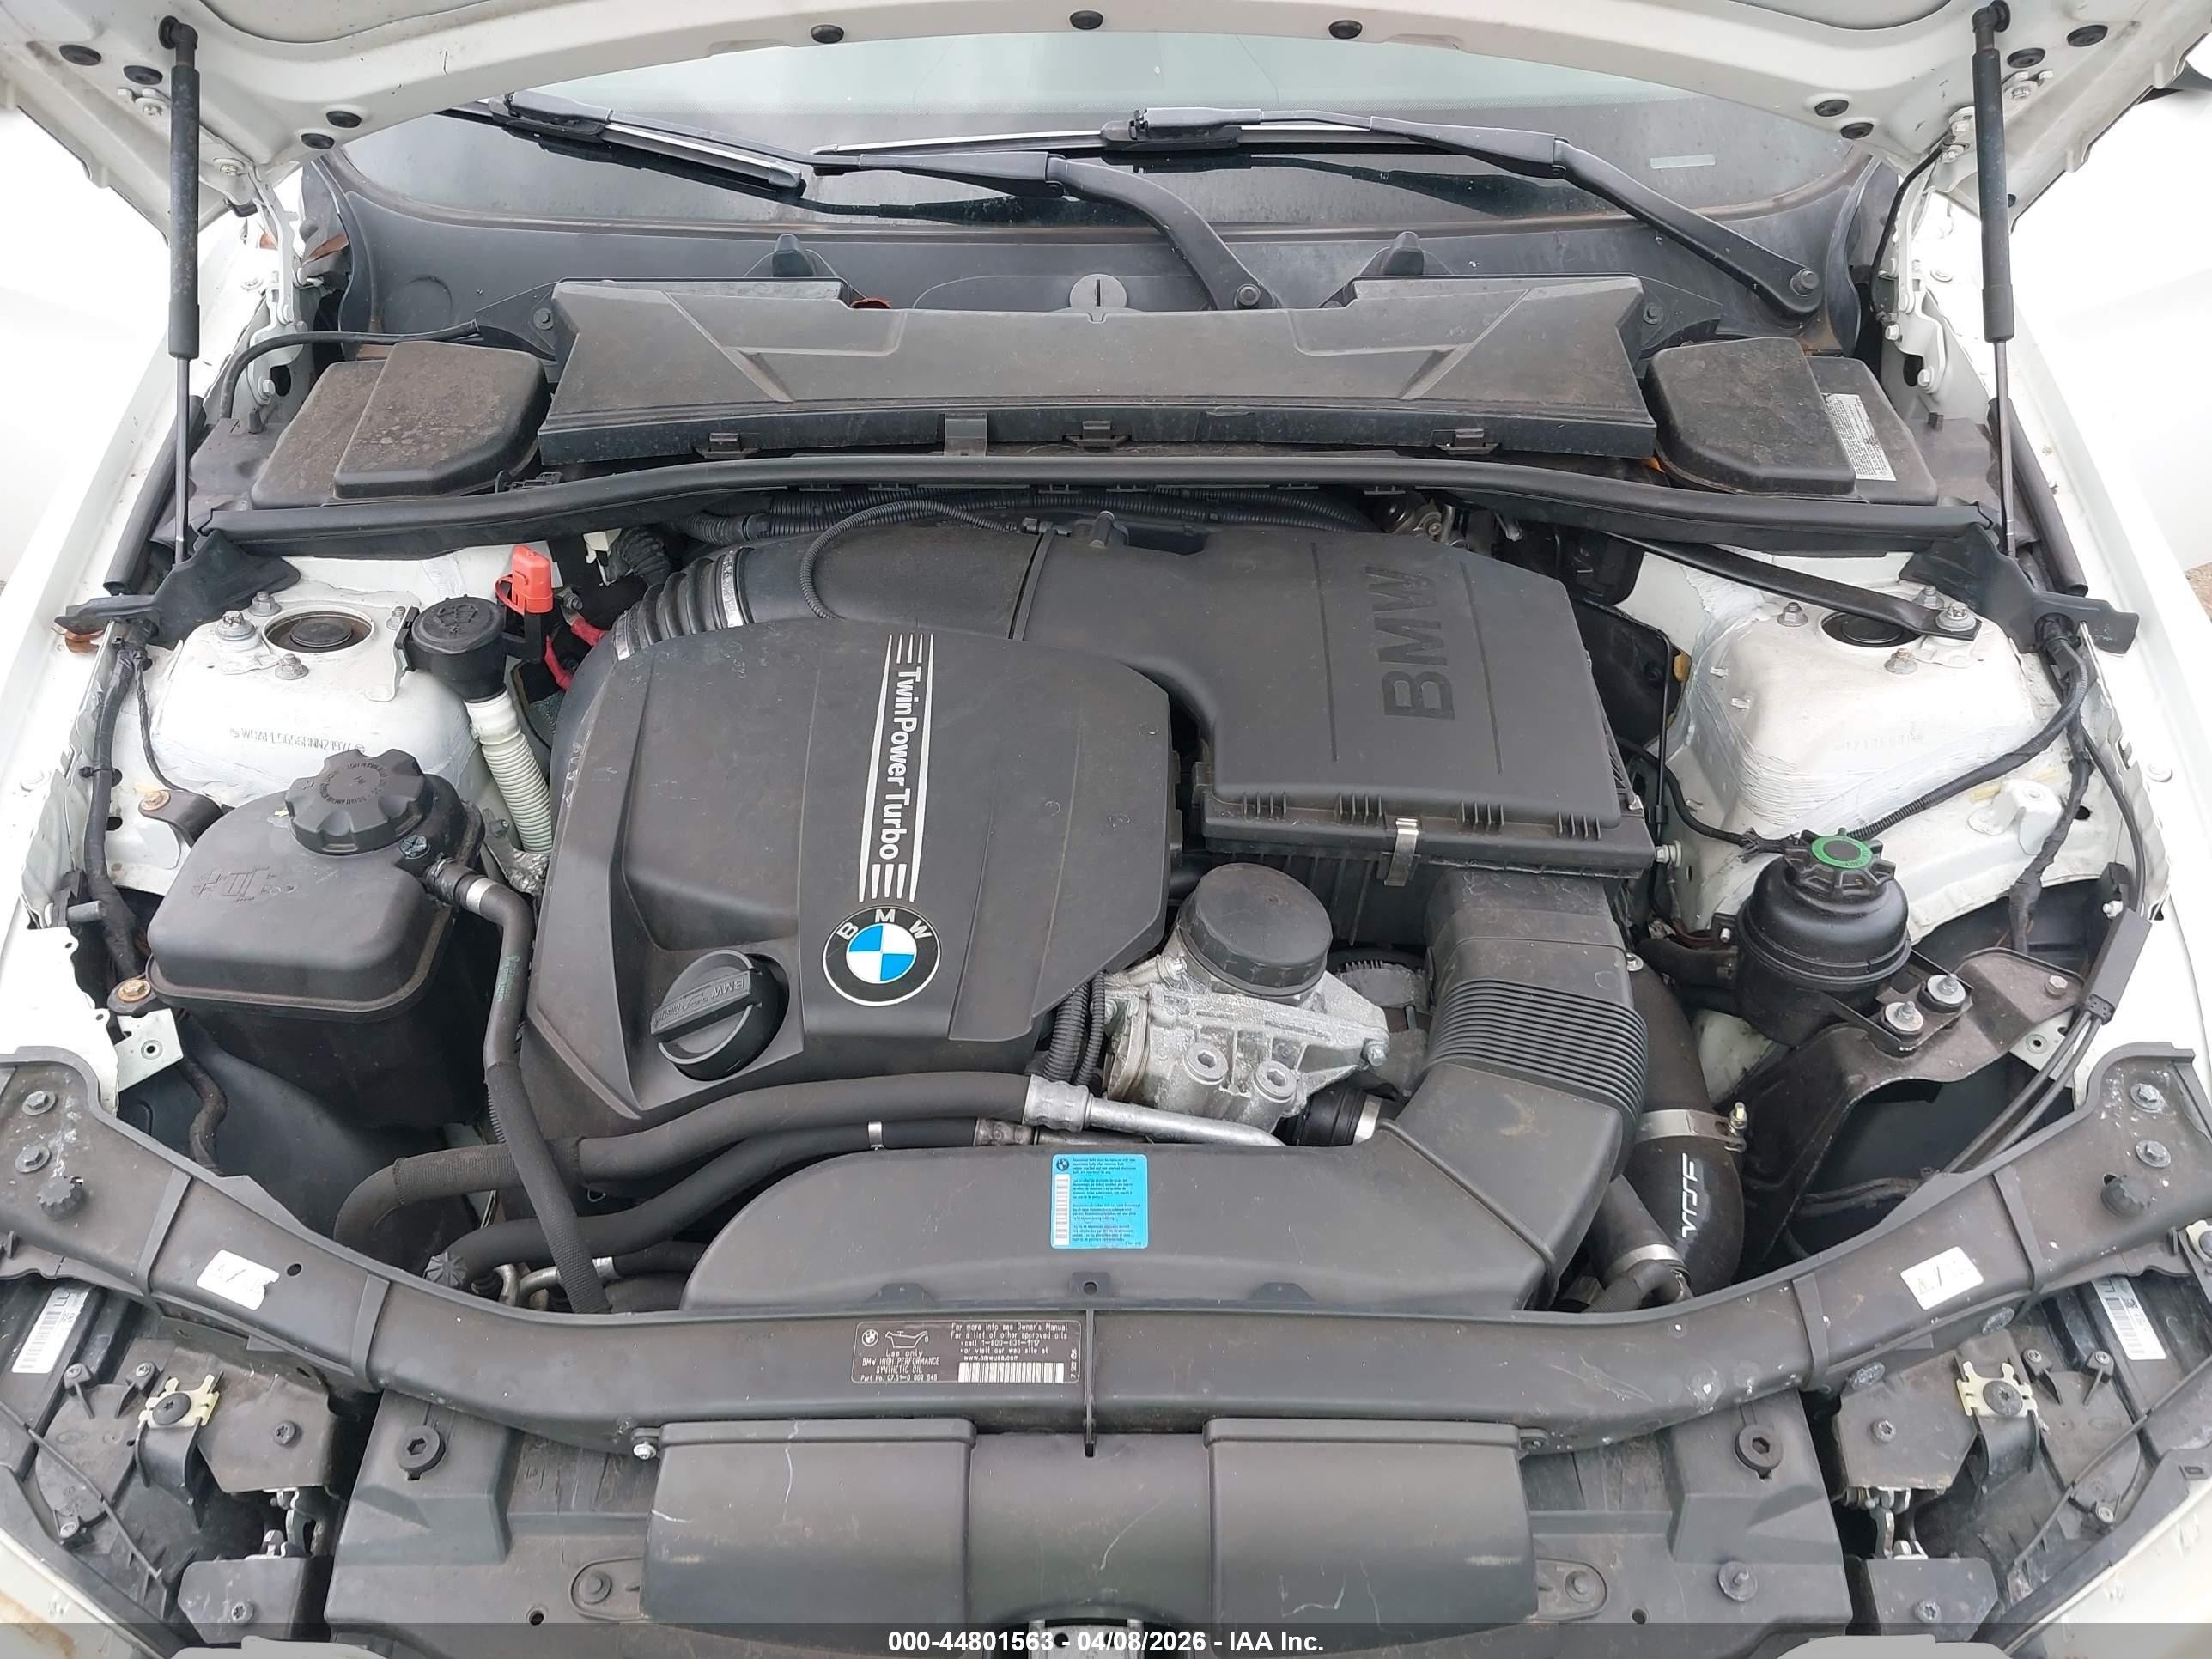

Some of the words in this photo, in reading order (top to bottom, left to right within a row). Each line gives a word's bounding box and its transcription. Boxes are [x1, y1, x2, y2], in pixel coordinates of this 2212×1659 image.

[1364, 566, 1455, 720] BMW
[887, 666, 921, 787] TwinPower
[879, 788, 911, 860] Turbo
[836, 908, 933, 940] BMW
[711, 977, 745, 999] BMW
[951, 1322, 963, 1331] For
[985, 1322, 999, 1331] info
[1017, 1322, 1042, 1331] Owner's
[1045, 1322, 1068, 1331] Manual
[951, 1331, 962, 1340] For
[988, 1330, 997, 1339] of
[1021, 1331, 1051, 1340] approved
[885, 1348, 900, 1357] Use
[905, 1348, 923, 1358] only
[862, 1358, 877, 1366] BMW
[879, 1358, 894, 1366] HIGH
[896, 1357, 941, 1366] PERFORMANCE
[876, 1365, 908, 1374] SYNTHETIC
[912, 1365, 923, 1374] OIL
